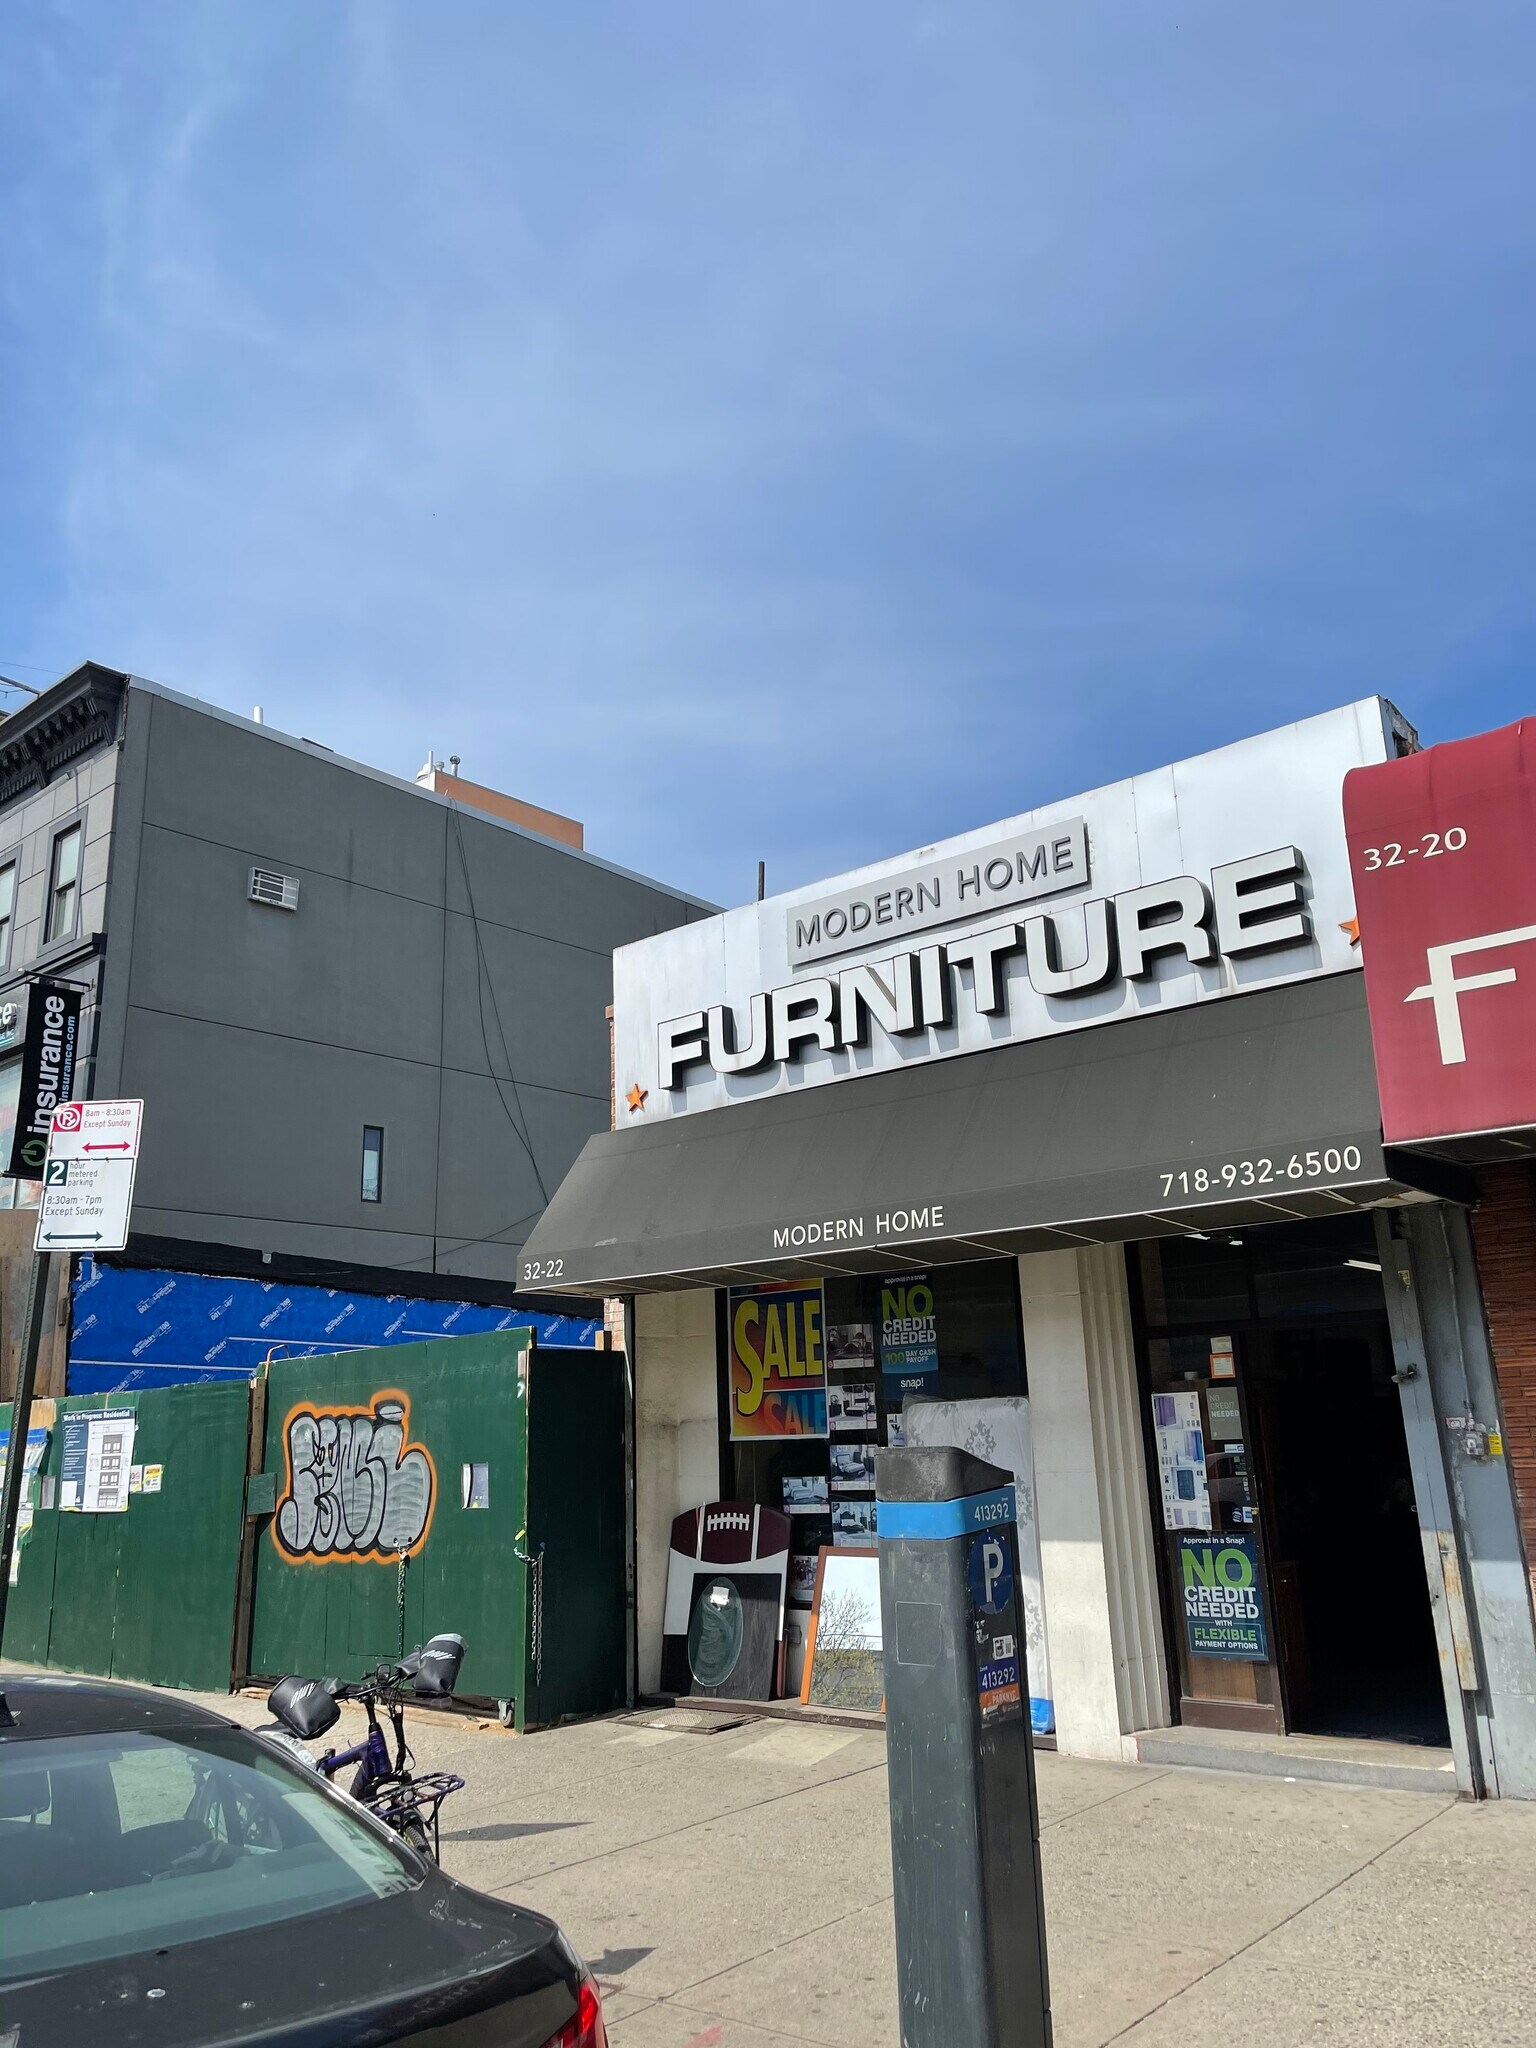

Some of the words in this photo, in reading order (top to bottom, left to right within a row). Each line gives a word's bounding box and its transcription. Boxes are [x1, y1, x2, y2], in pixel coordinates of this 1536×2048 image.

[1363, 827, 1467, 871] 32-20
[796, 877, 940, 947] MODERN
[957, 836, 1073, 900] HOME
[657, 845, 1311, 1091] FURNITURE
[27, 996, 65, 1134] insurance
[85, 1109, 100, 1117] 8am
[106, 1108, 131, 1116] 8:30am
[84, 1120, 106, 1128] Except
[107, 1119, 131, 1128] Sunday
[48, 1161, 65, 1184] 2
[68, 1170, 98, 1178] metered
[1159, 1145, 1361, 1197] 718-932-6500
[67, 1179, 94, 1188] parking
[46, 1195, 78, 1204] 8:30am
[85, 1195, 102, 1205] 7pm
[45, 1207, 73, 1217] Except
[75, 1207, 104, 1217] Sunday
[773, 1217, 864, 1248] MODERN
[876, 1205, 944, 1234] HOME
[523, 1259, 564, 1281] 32-22
[881, 1284, 934, 1320] NO
[882, 1315, 936, 1333] CREDIT
[882, 1329, 937, 1346] NEEDED
[734, 1299, 823, 1415] SALE
[885, 1351, 905, 1366] 100
[900, 1377, 924, 1389] snap!
[764, 1392, 826, 1435] SALE
[1210, 1401, 1234, 1409] CREDIT
[103, 1410, 130, 1418] Residential
[974, 1503, 1009, 1521] 413292
[1180, 1548, 1252, 1588] NO
[1184, 1586, 1256, 1603] CREDIT
[1185, 1602, 1259, 1619] NEEDED
[1194, 1627, 1257, 1641] FLEXIBLE
[1195, 1640, 1226, 1648] PAYMENT
[1228, 1641, 1258, 1650] OPTIONS
[981, 1666, 1015, 1689] 413292
